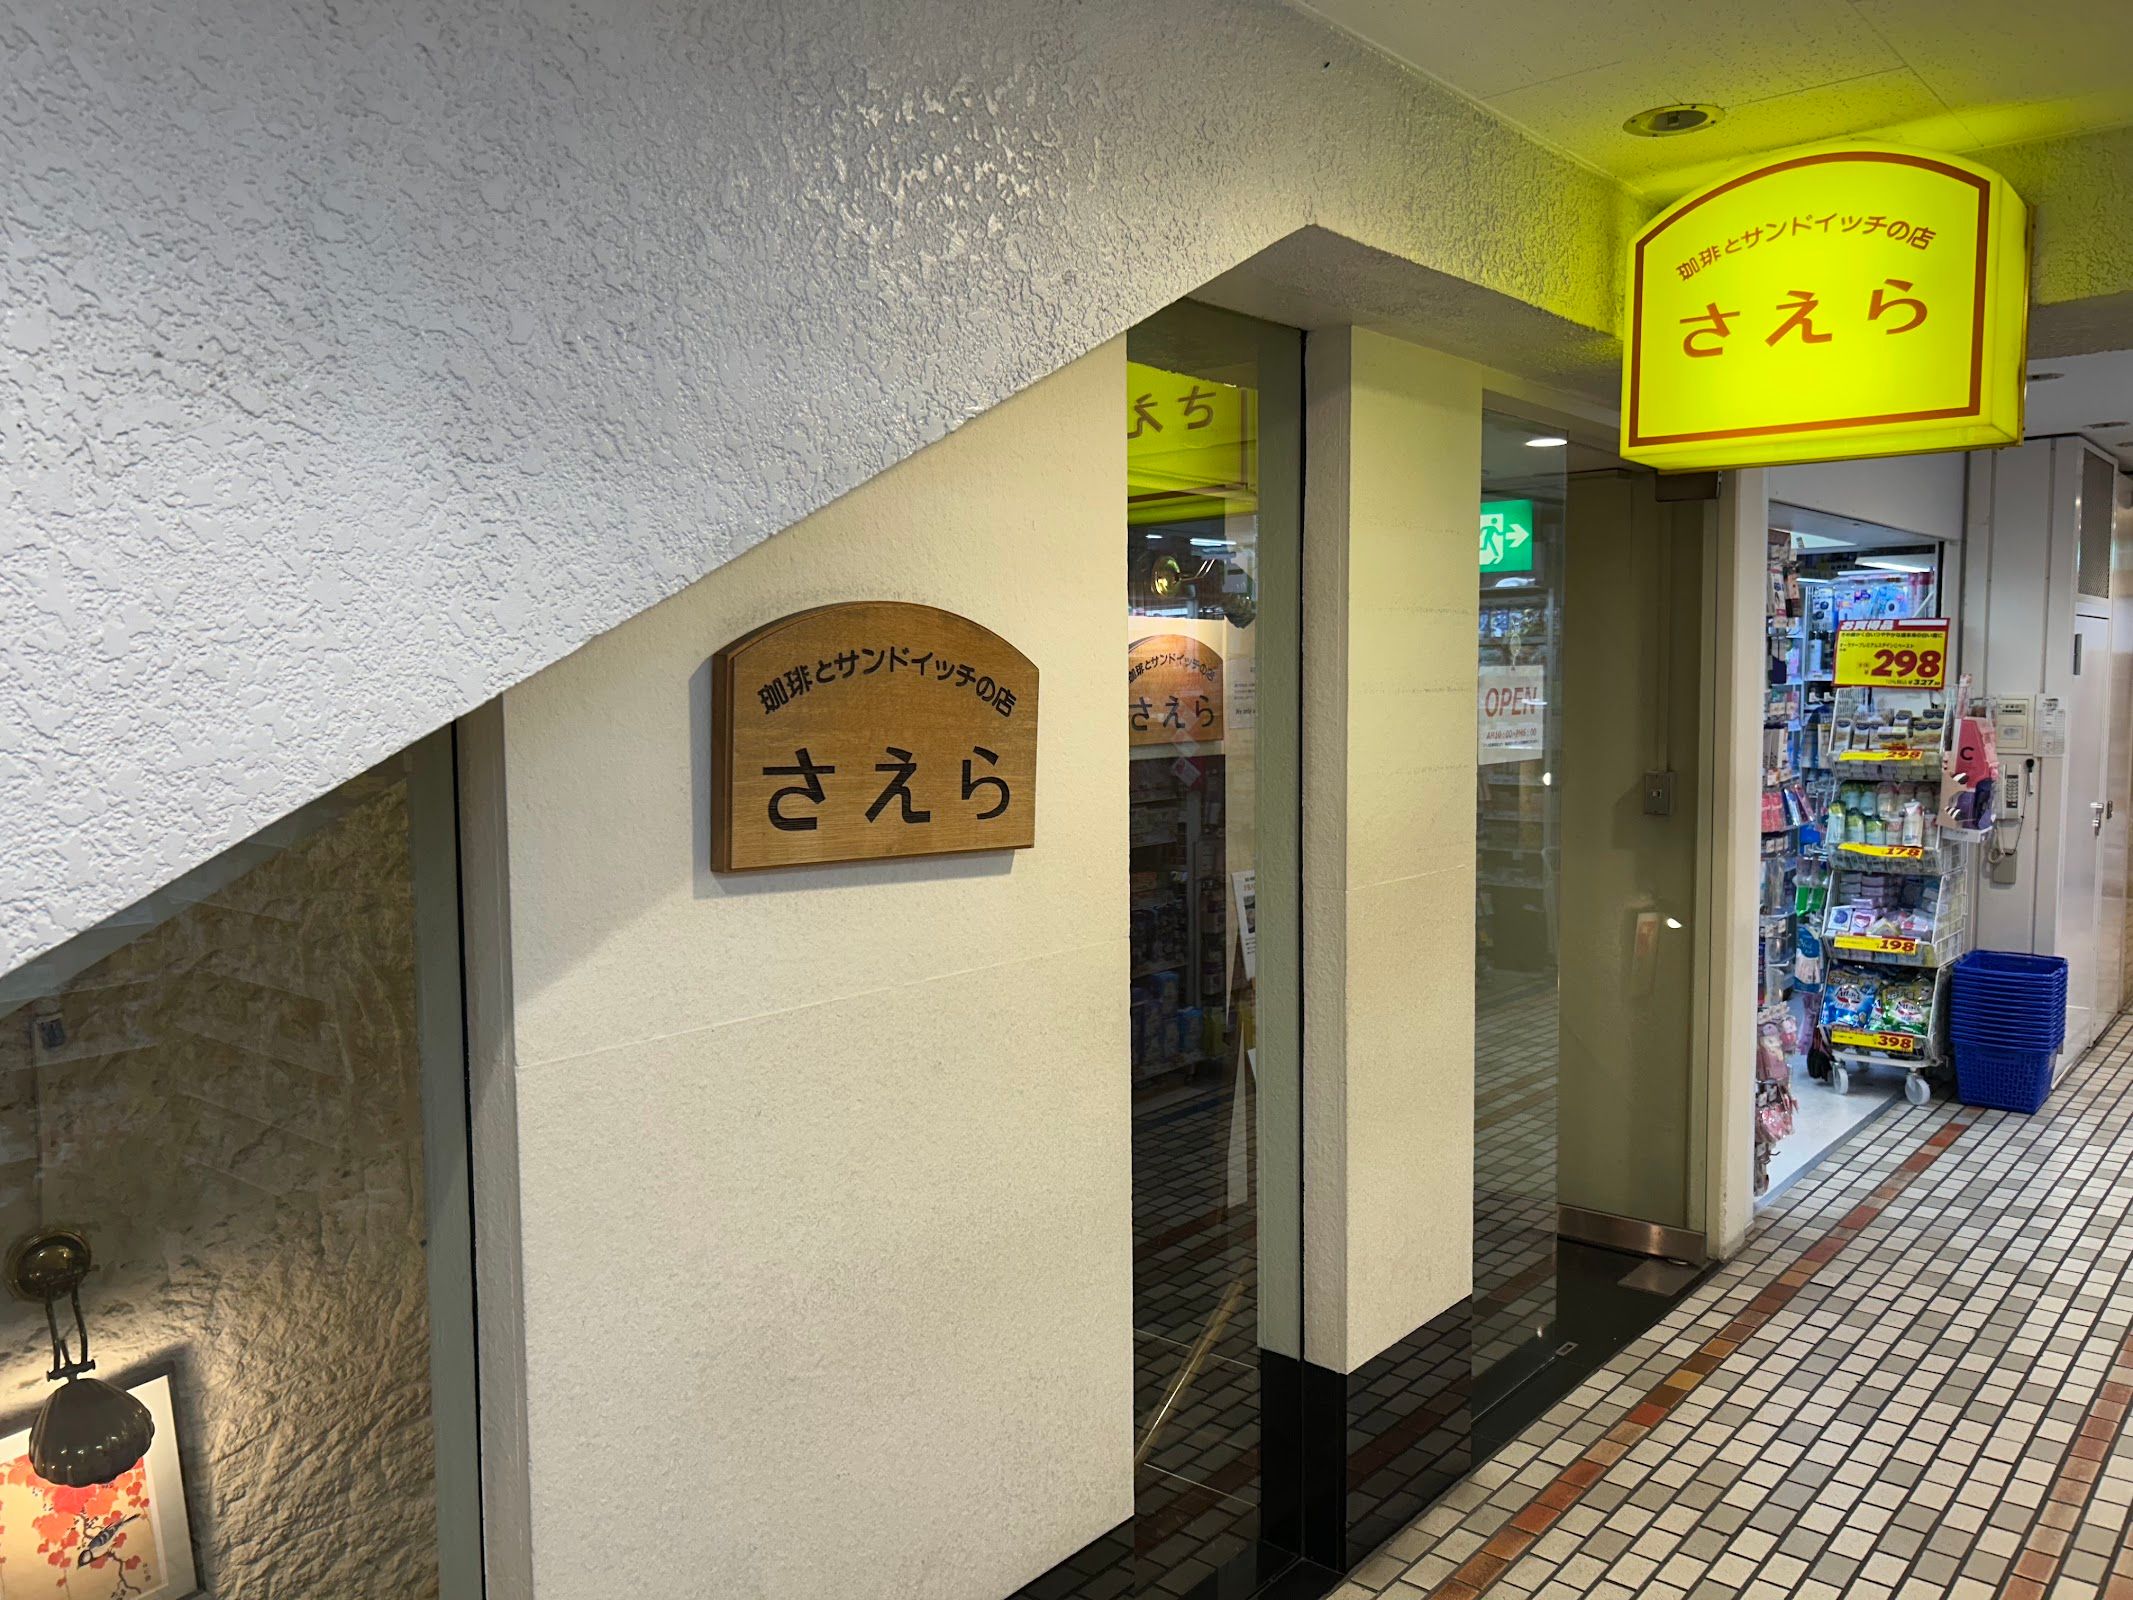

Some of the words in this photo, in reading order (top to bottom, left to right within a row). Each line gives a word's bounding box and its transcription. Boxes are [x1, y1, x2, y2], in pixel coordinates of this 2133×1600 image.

[1680, 278, 1928, 358] さえら
[1871, 649, 1942, 678] 298
[1129, 695, 1214, 731] さえら
[1485, 687, 1538, 717] OPEN
[763, 746, 1010, 831] さえら
[1880, 939, 1915, 952] 198
[1877, 1035, 1912, 1049] 398
